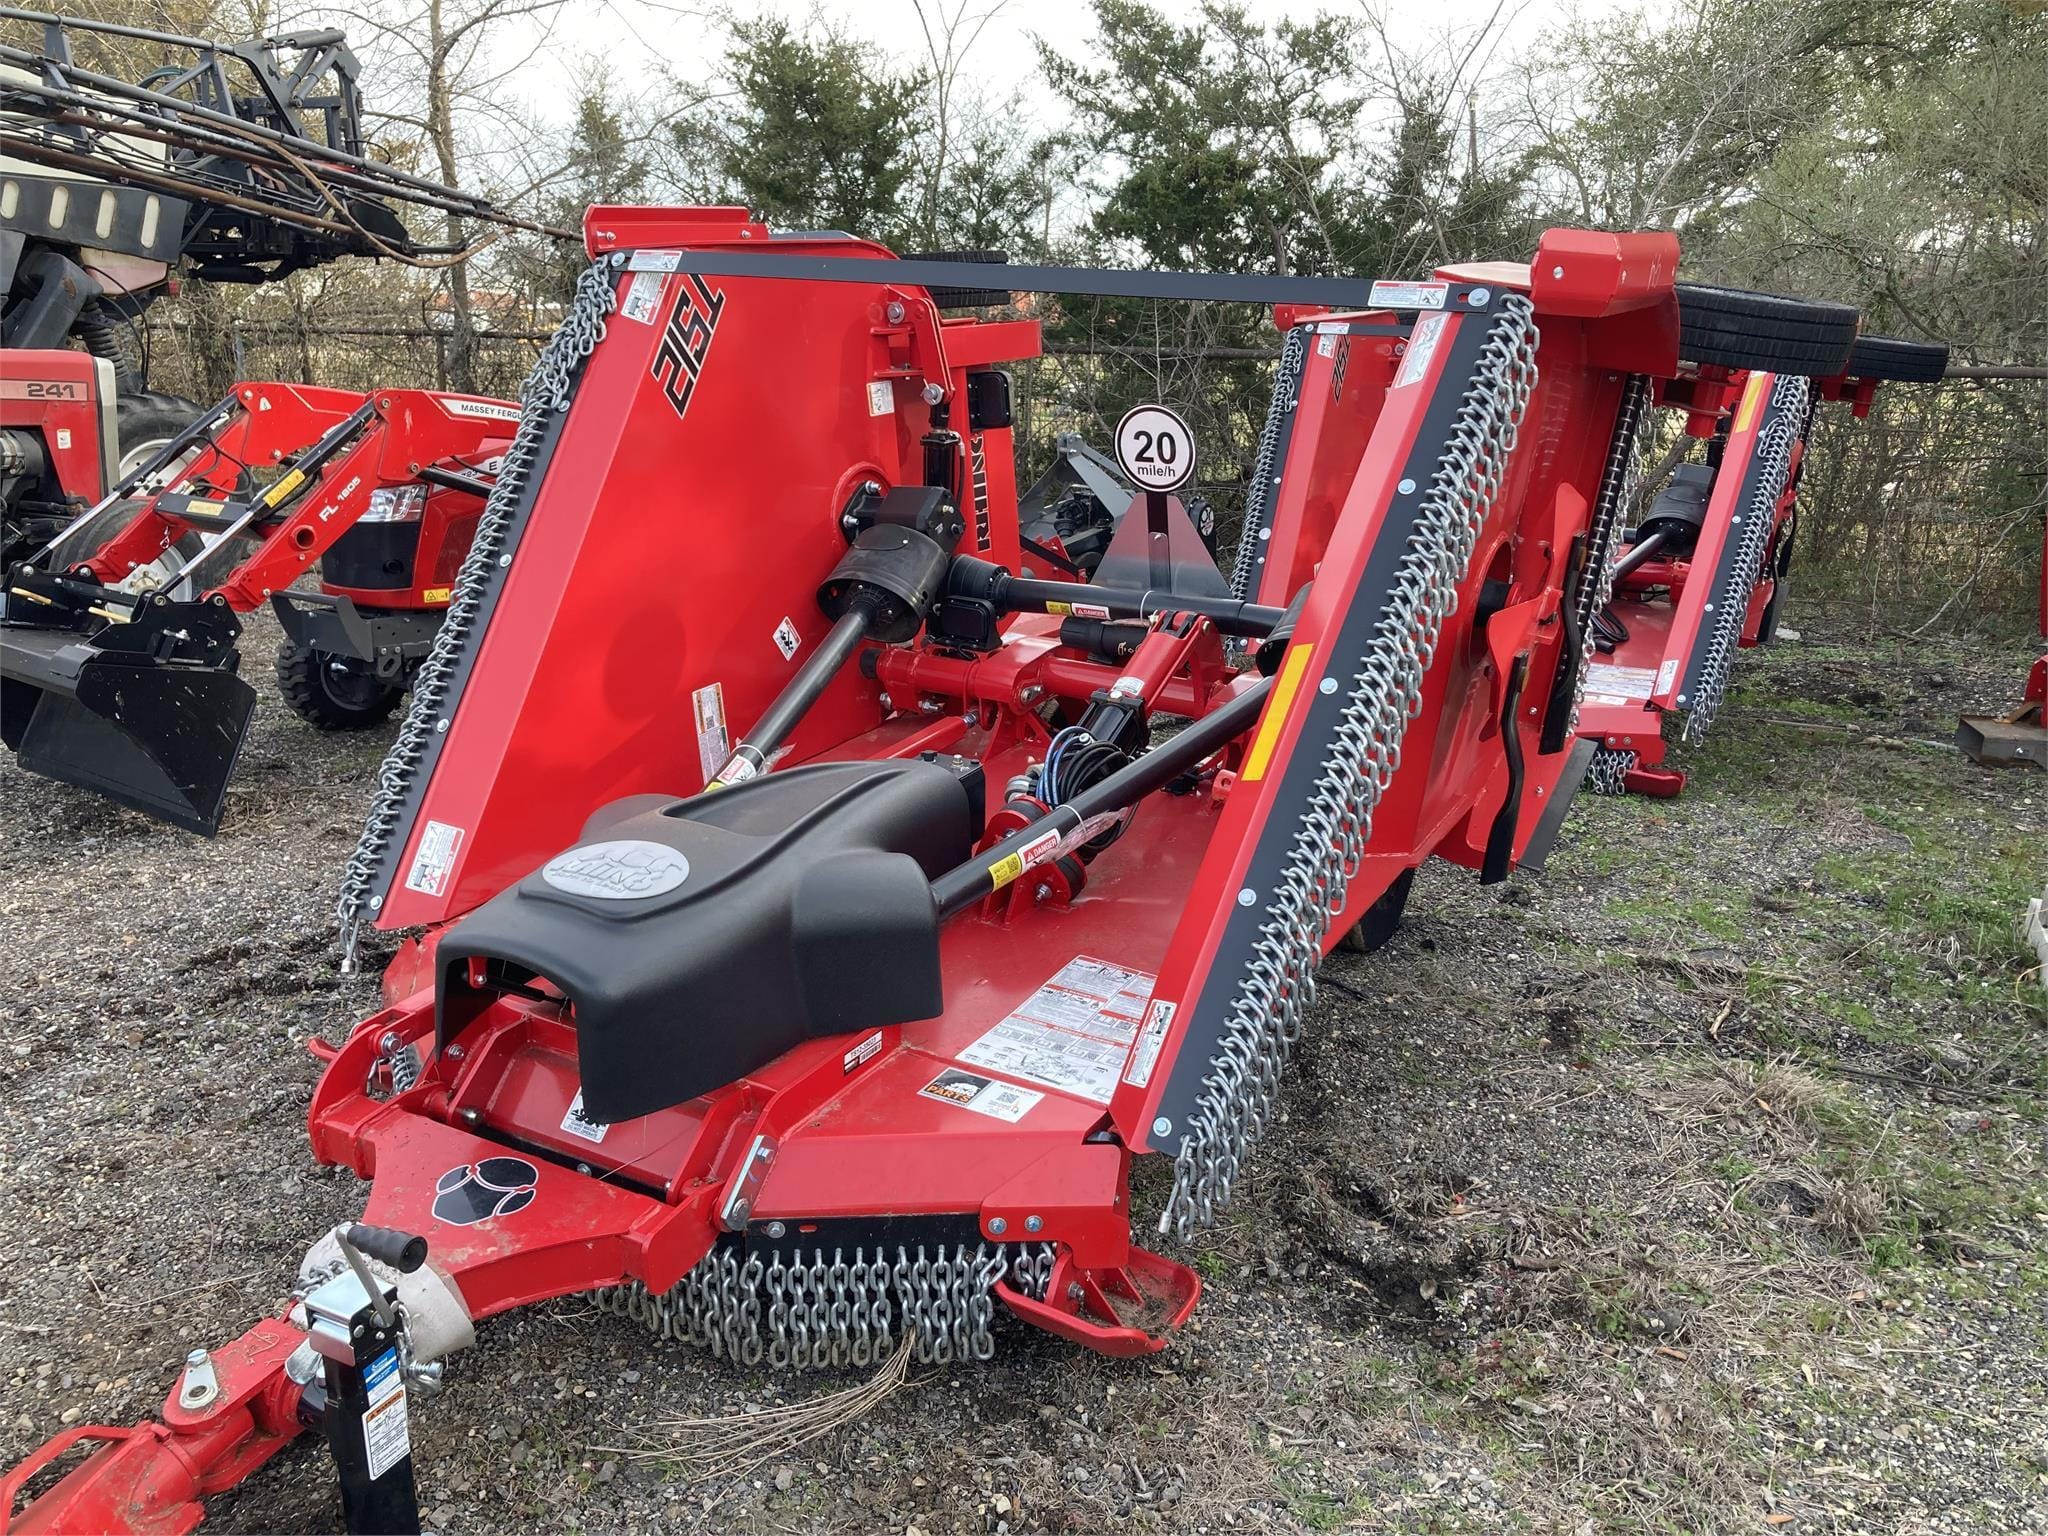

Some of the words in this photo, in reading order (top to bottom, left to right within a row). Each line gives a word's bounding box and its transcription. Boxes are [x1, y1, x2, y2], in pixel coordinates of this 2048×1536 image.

[27, 383, 75, 398] 241
[461, 404, 495, 415] MASSEY
[1133, 430, 1177, 464] 20
[1137, 465, 1176, 477] mile/h
[319, 505, 339, 522] FL
[1033, 838, 1057, 856] DANGER
[926, 1085, 970, 1103] PARTS
